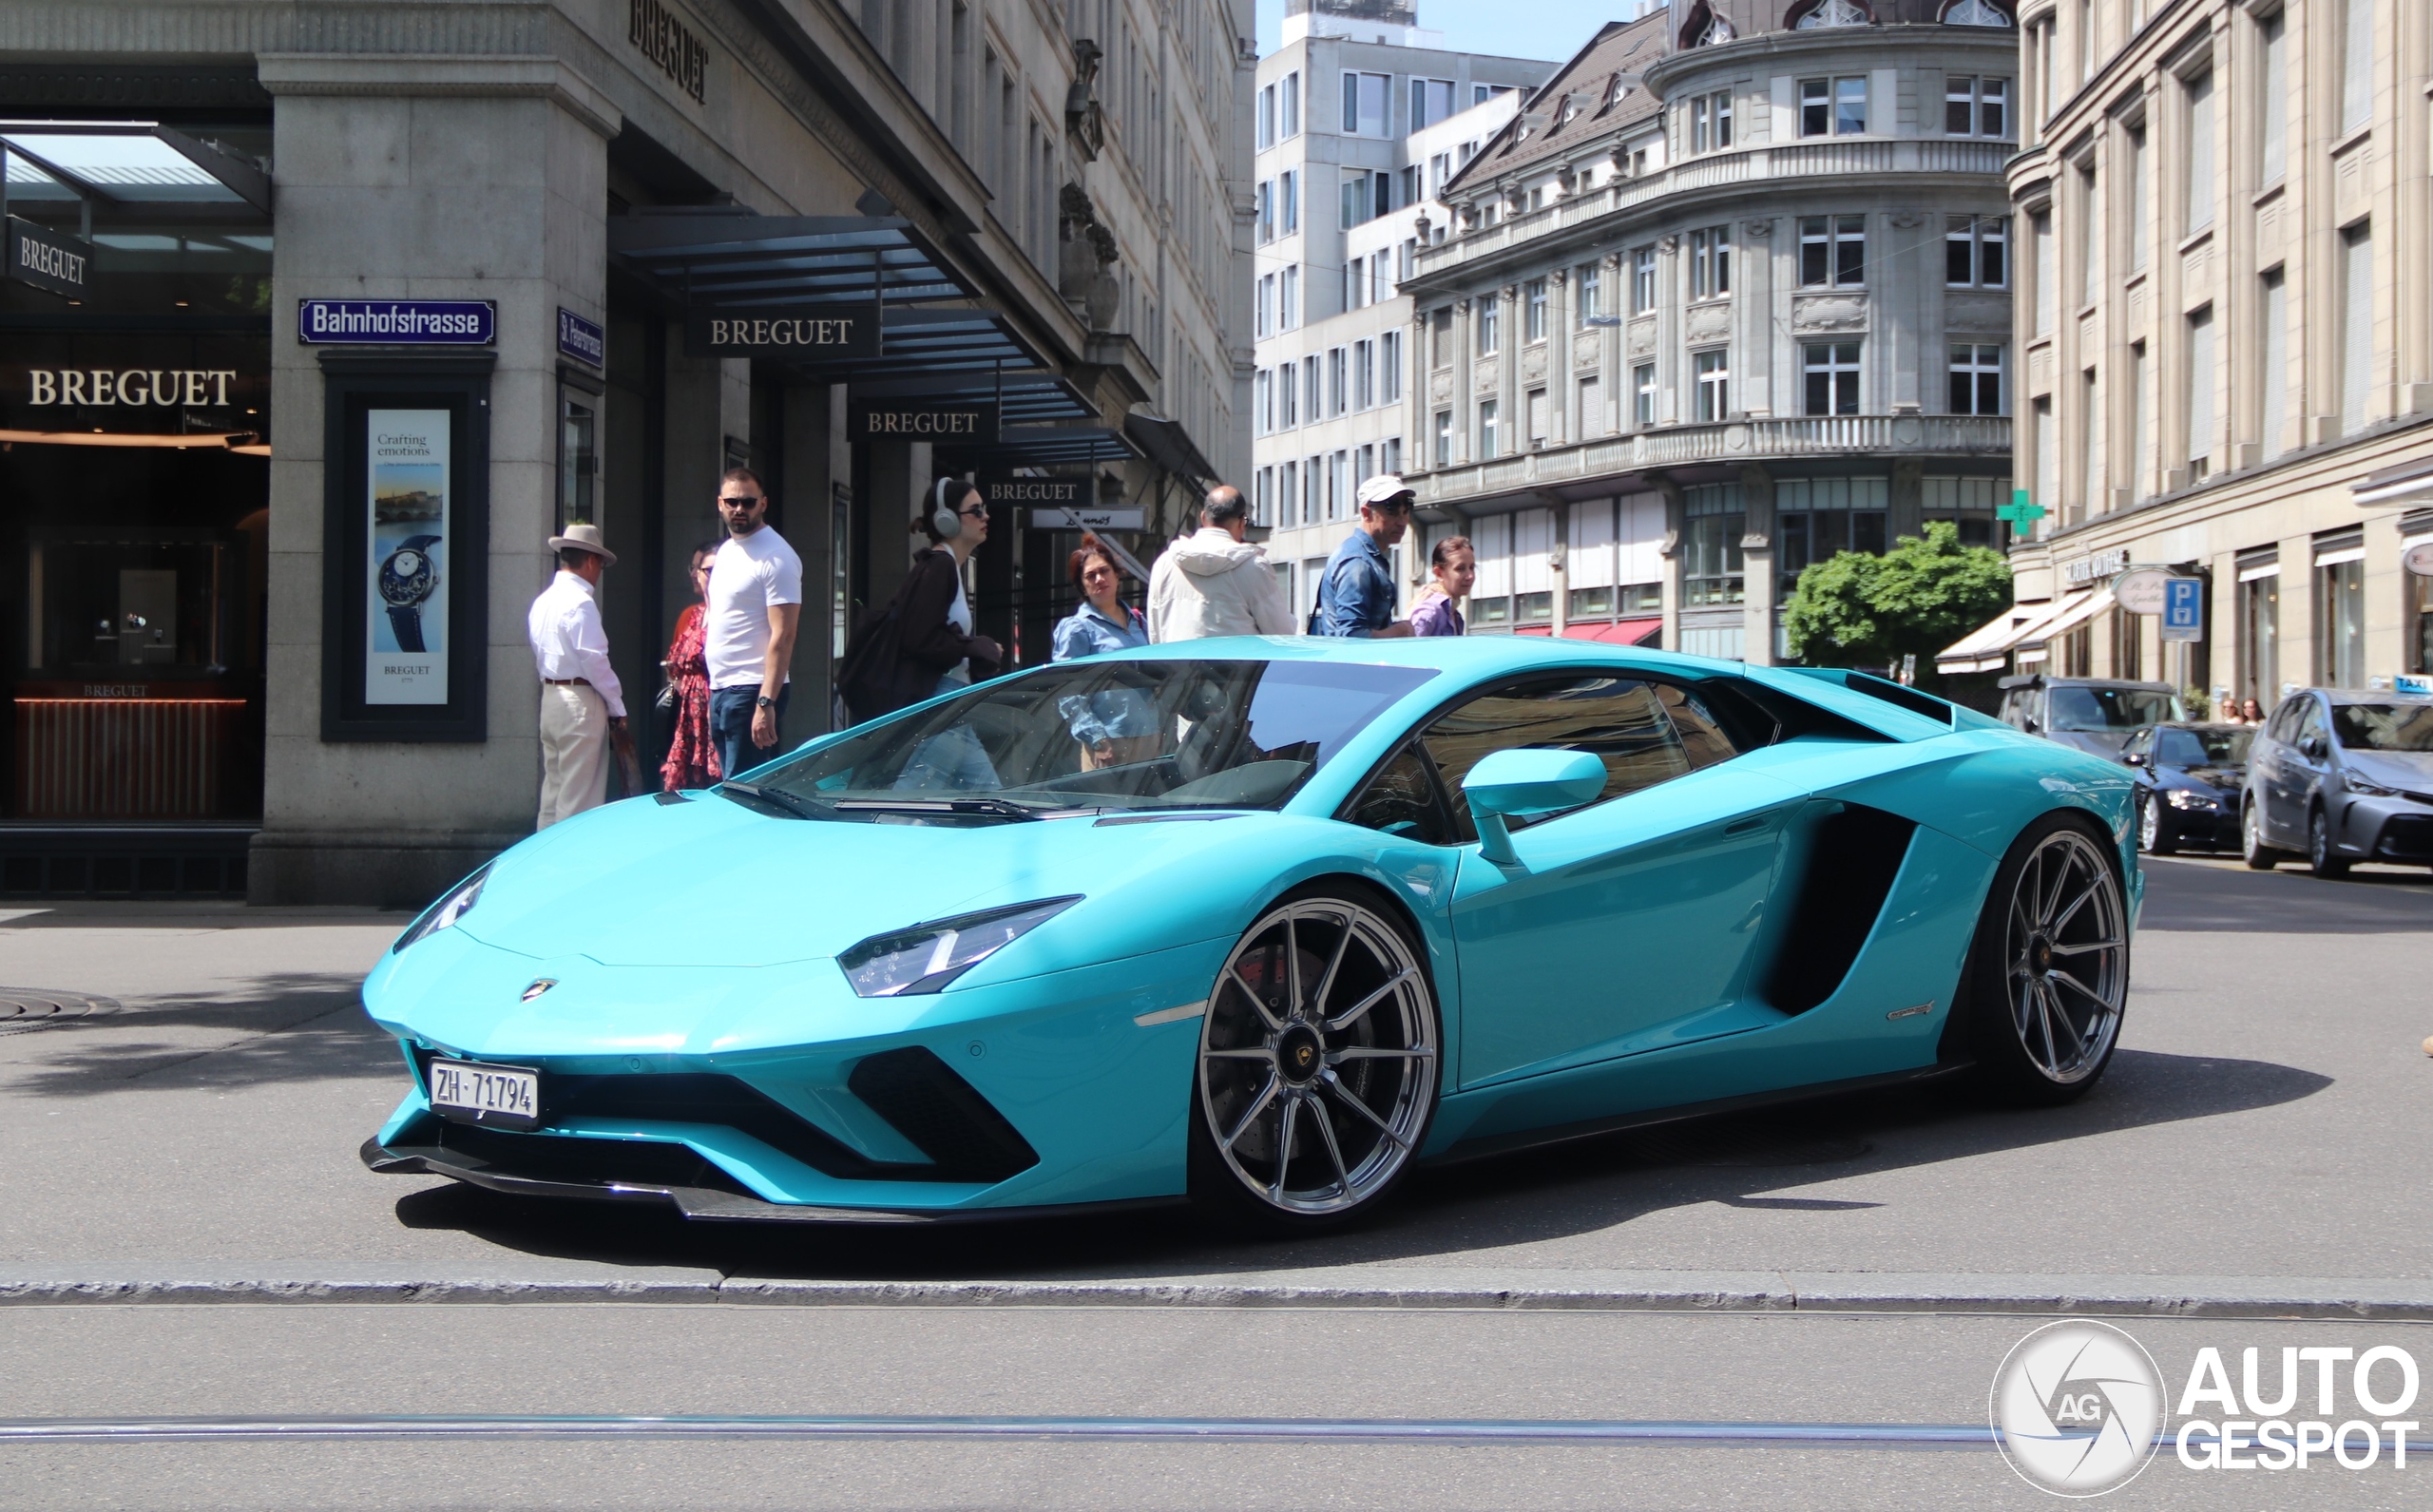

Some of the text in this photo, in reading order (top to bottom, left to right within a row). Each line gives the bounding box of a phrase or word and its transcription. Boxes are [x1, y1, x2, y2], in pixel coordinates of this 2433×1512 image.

[628, 0, 709, 105] BREGUET
[21, 236, 86, 285] BREGUET
[313, 304, 479, 334] Bahnhofstrasse
[710, 318, 853, 345] BREGUET
[29, 369, 237, 407] BREGUET
[867, 412, 979, 433] BREGUET
[377, 433, 427, 448] Crafting
[377, 446, 431, 456] emotions
[990, 484, 1078, 500] BREGUET
[2174, 584, 2192, 607] P
[384, 666, 431, 675] BREGUET
[84, 684, 149, 698] BREGUET
[2397, 678, 2427, 689] TAXI
